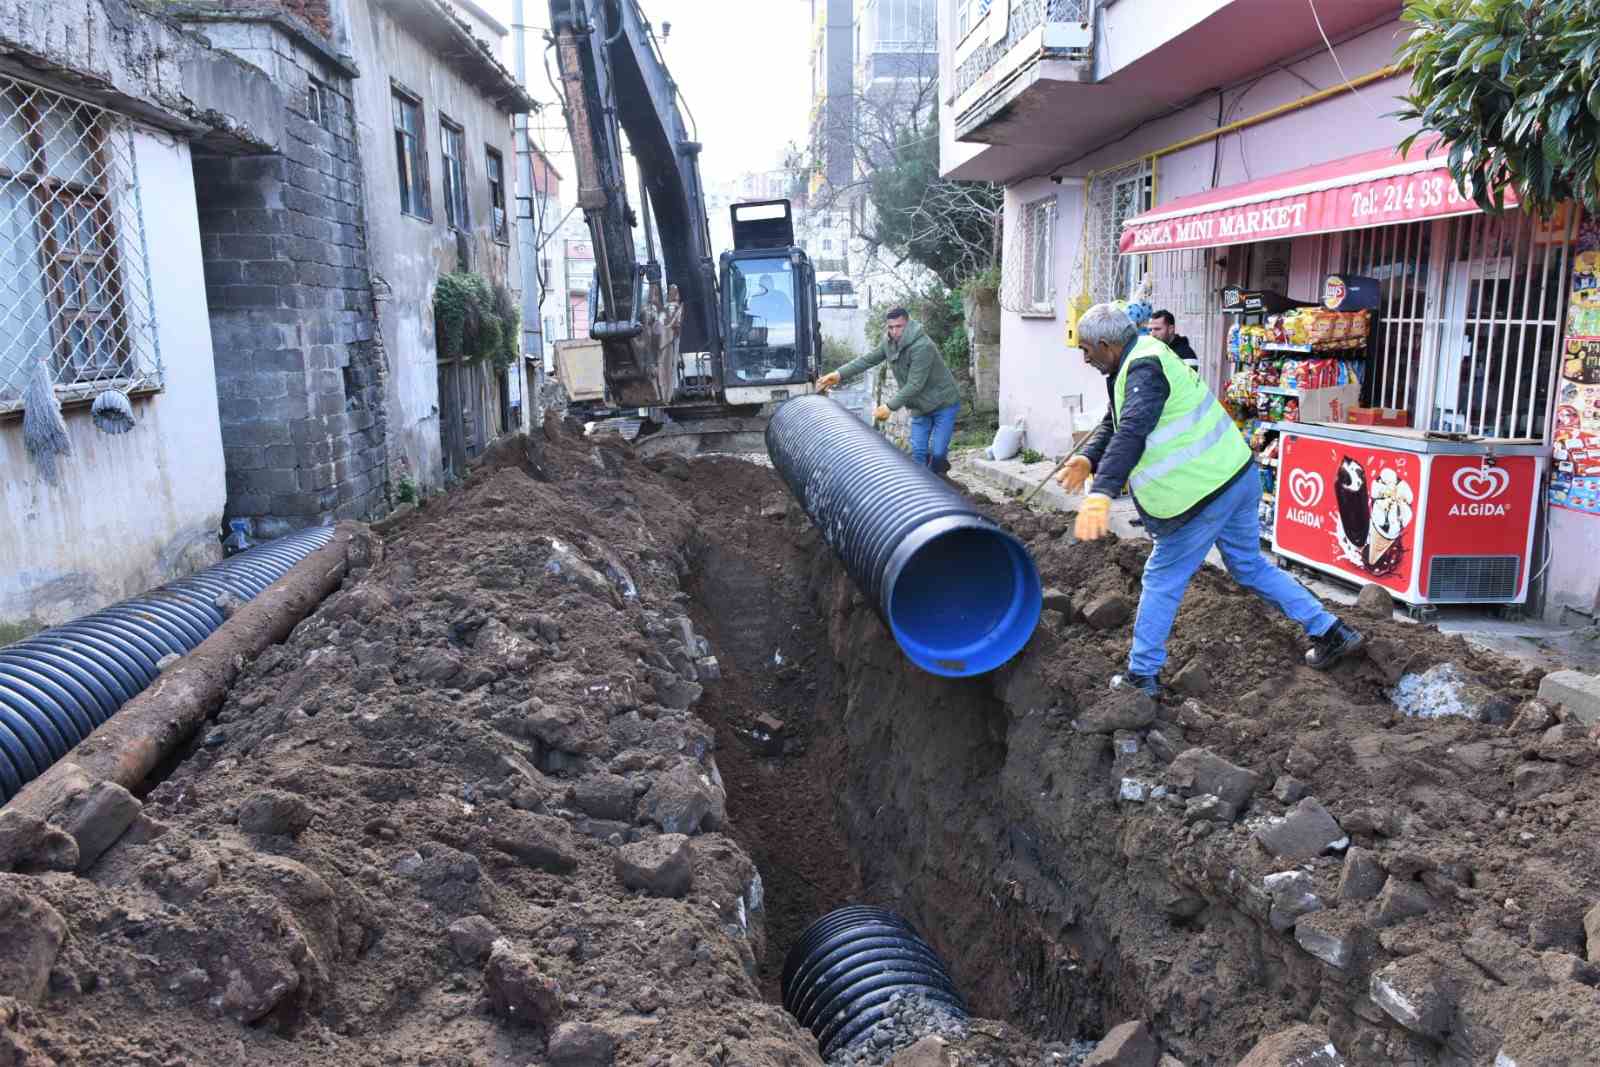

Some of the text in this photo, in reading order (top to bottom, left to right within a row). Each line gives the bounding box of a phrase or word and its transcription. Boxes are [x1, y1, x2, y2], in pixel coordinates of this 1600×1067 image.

[1218, 202, 1307, 238] MARKET
[1383, 182, 1416, 210] 214
[1419, 176, 1443, 208] 33
